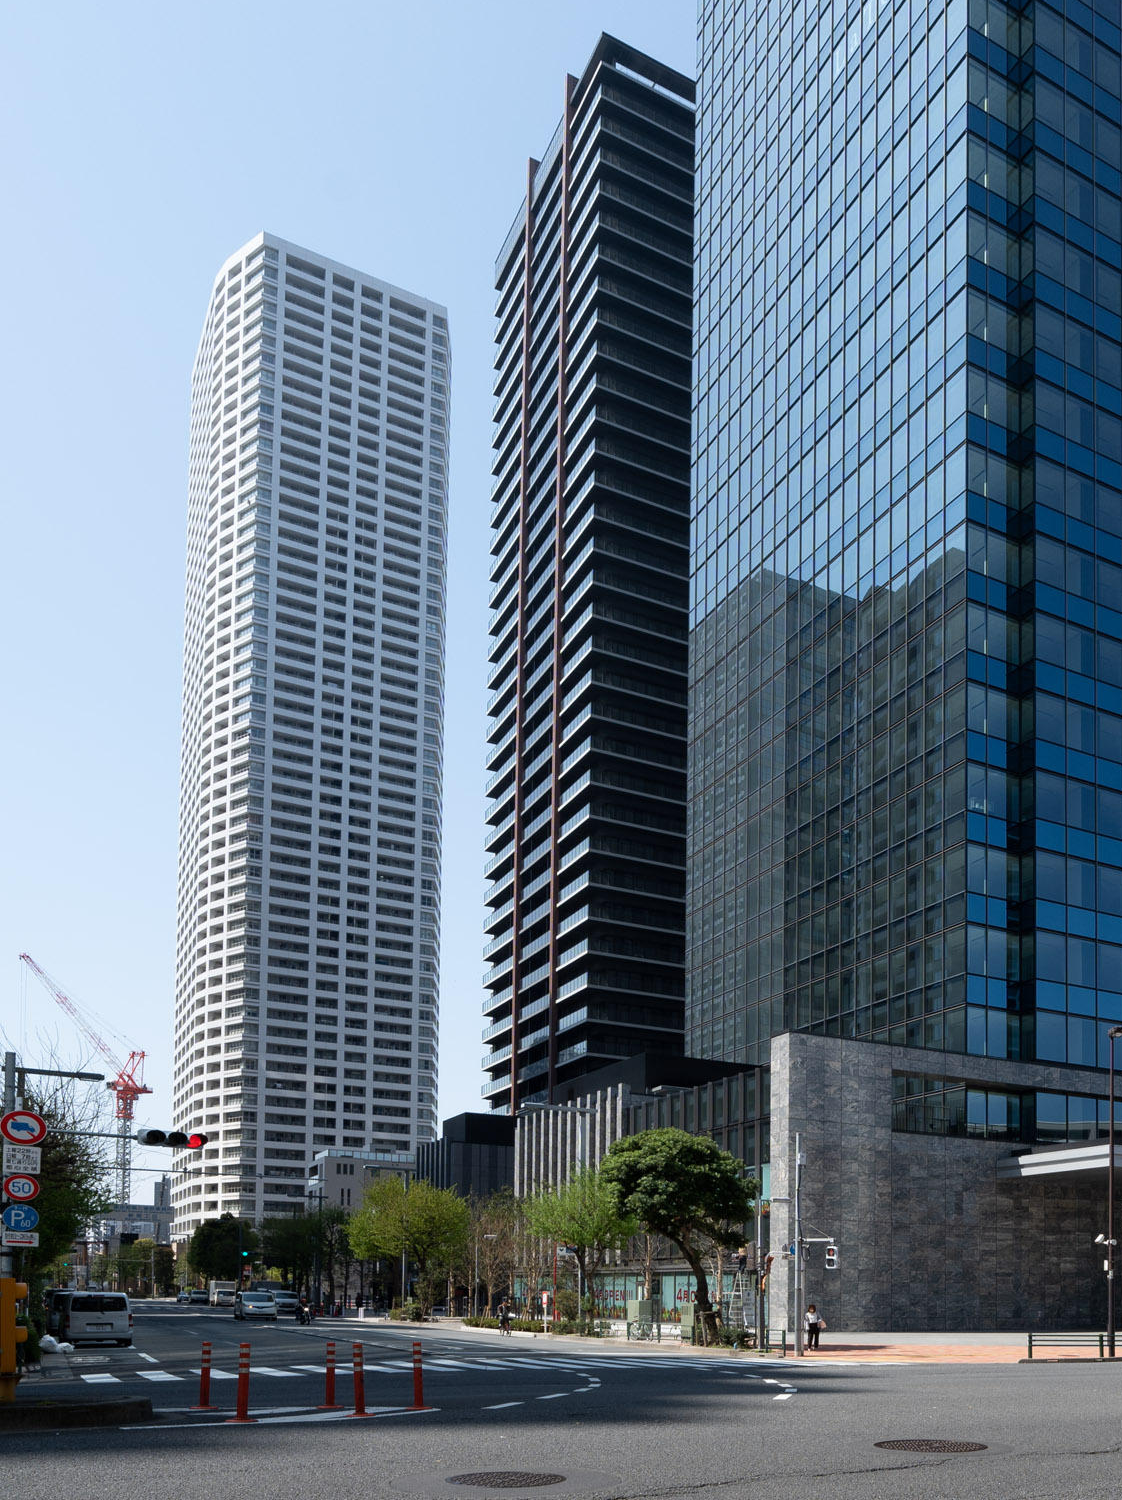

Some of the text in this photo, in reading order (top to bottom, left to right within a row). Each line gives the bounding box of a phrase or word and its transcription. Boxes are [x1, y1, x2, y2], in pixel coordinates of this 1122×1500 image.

[11, 1182, 31, 1193] 50
[10, 1210, 25, 1227] P
[20, 1219, 31, 1228] 60
